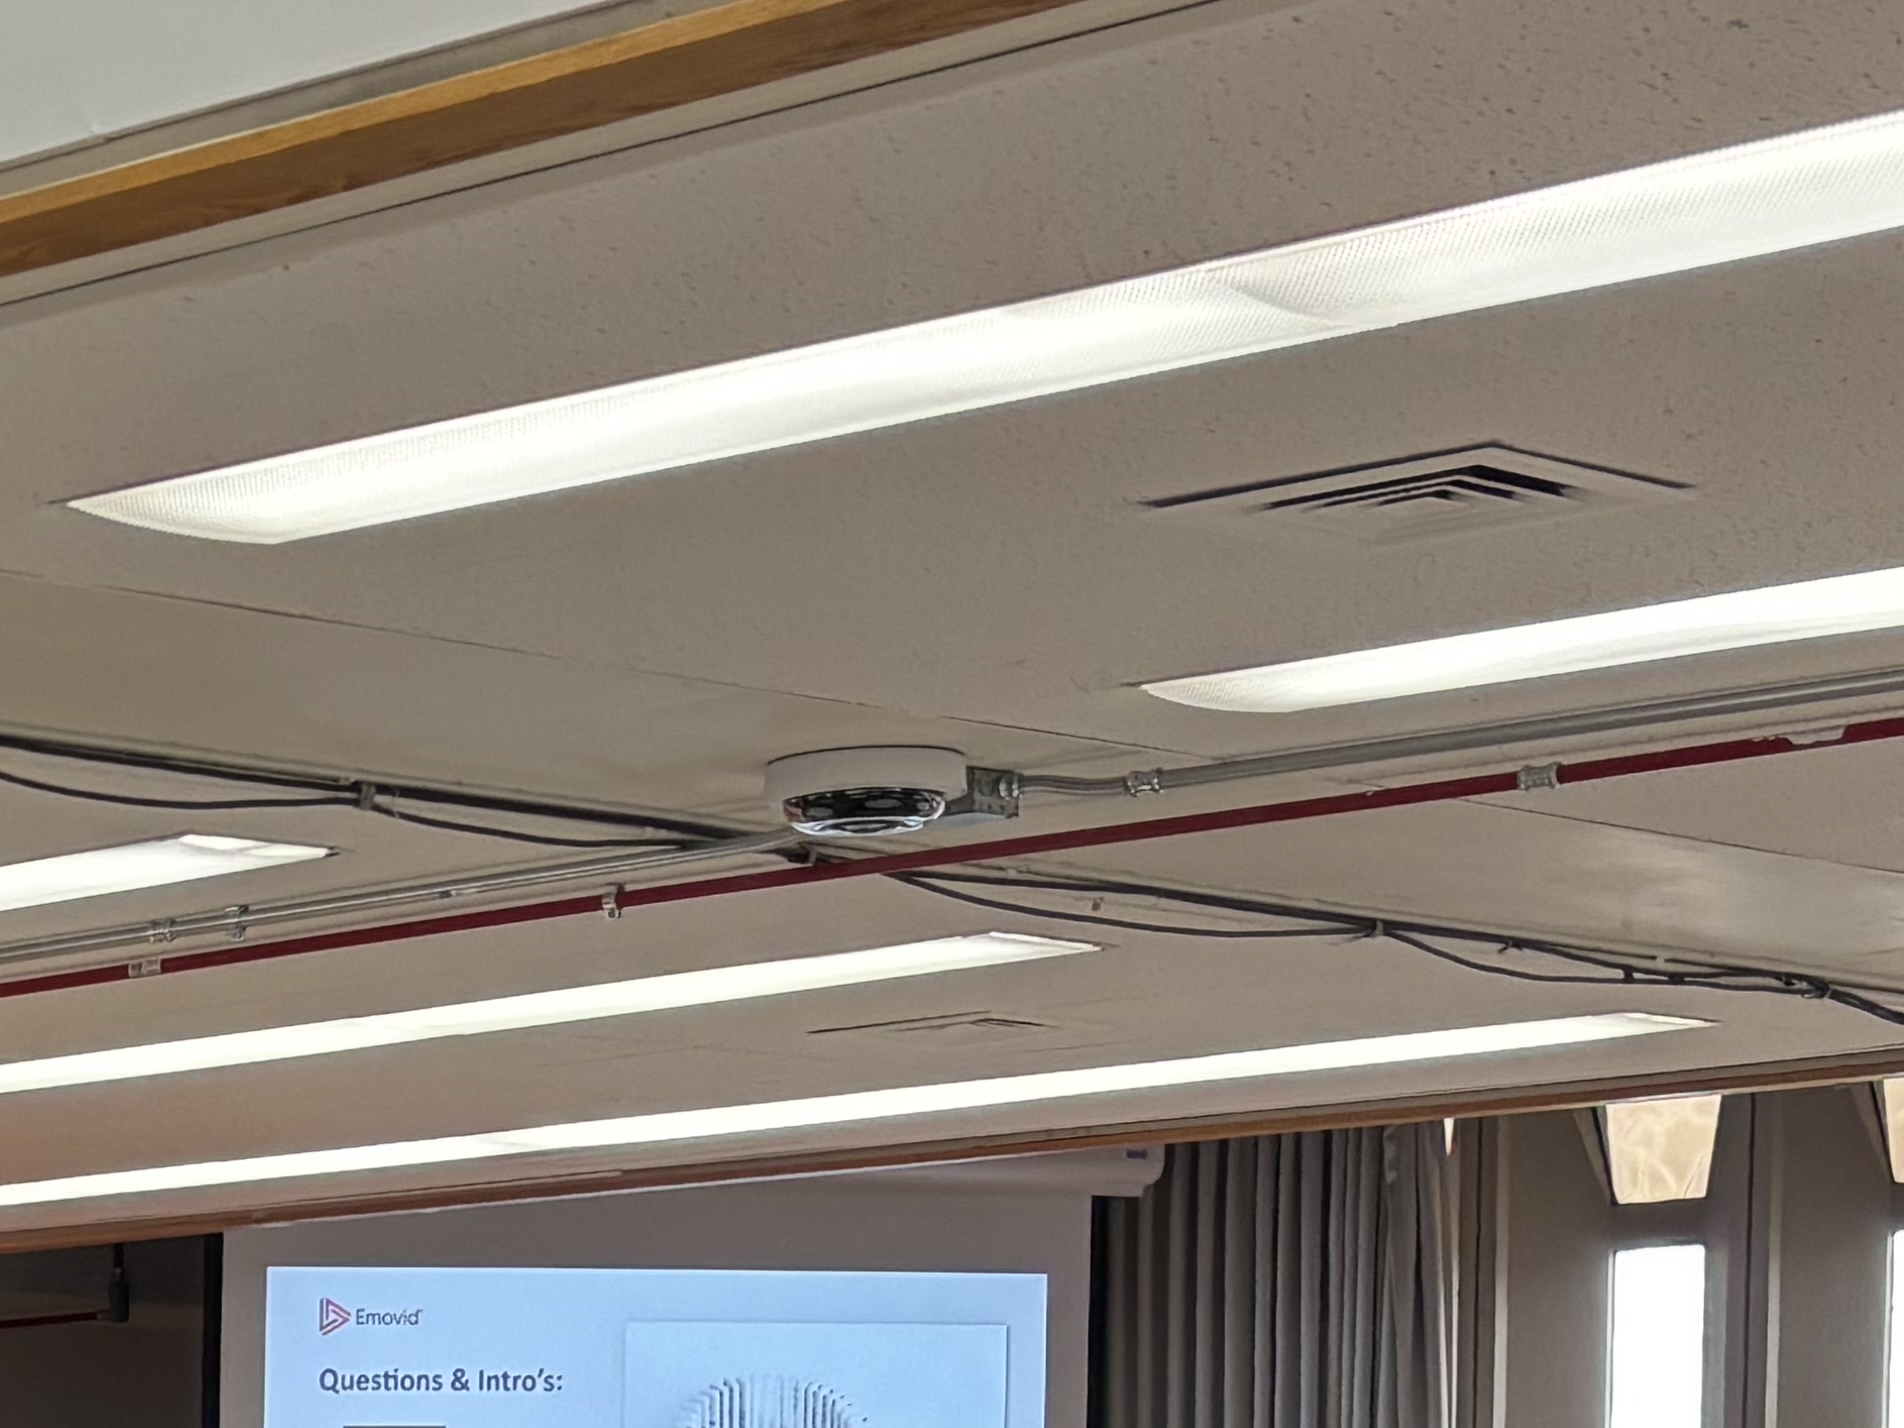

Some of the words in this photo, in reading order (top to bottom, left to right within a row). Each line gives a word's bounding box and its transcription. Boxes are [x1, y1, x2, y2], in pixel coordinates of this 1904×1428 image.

[355, 1308, 421, 1326] Emovid
[319, 1368, 442, 1394] Questions
[450, 1368, 470, 1391] &
